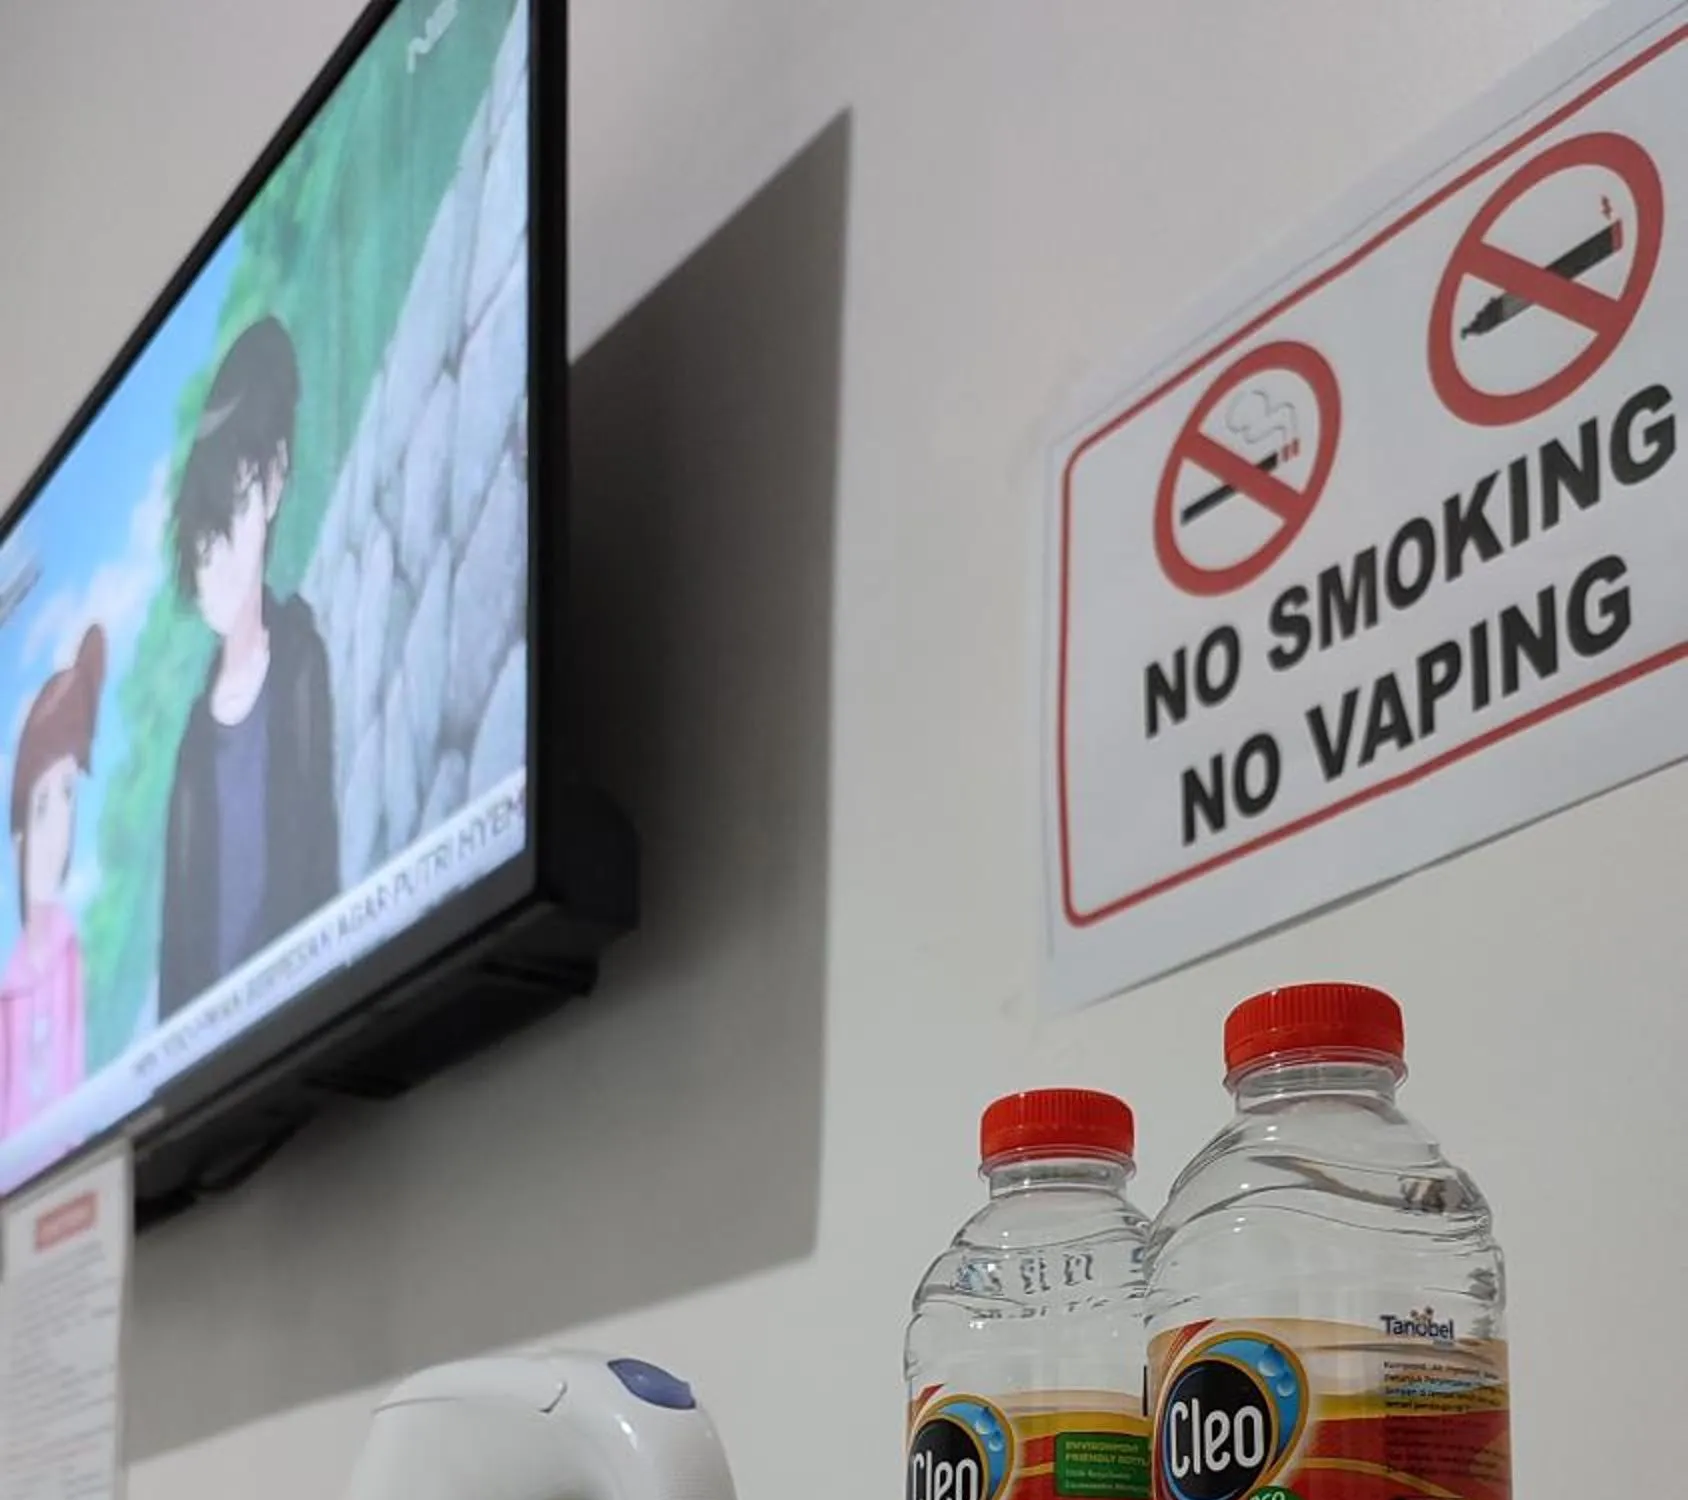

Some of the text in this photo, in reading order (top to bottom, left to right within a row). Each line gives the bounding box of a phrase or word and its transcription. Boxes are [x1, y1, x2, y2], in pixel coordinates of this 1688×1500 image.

[1144, 383, 1678, 739] NO SMOKING
[1180, 554, 1632, 847] NO VAPING
[1380, 1314, 1455, 1341] Tanobel
[1168, 1397, 1266, 1480] Cleo
